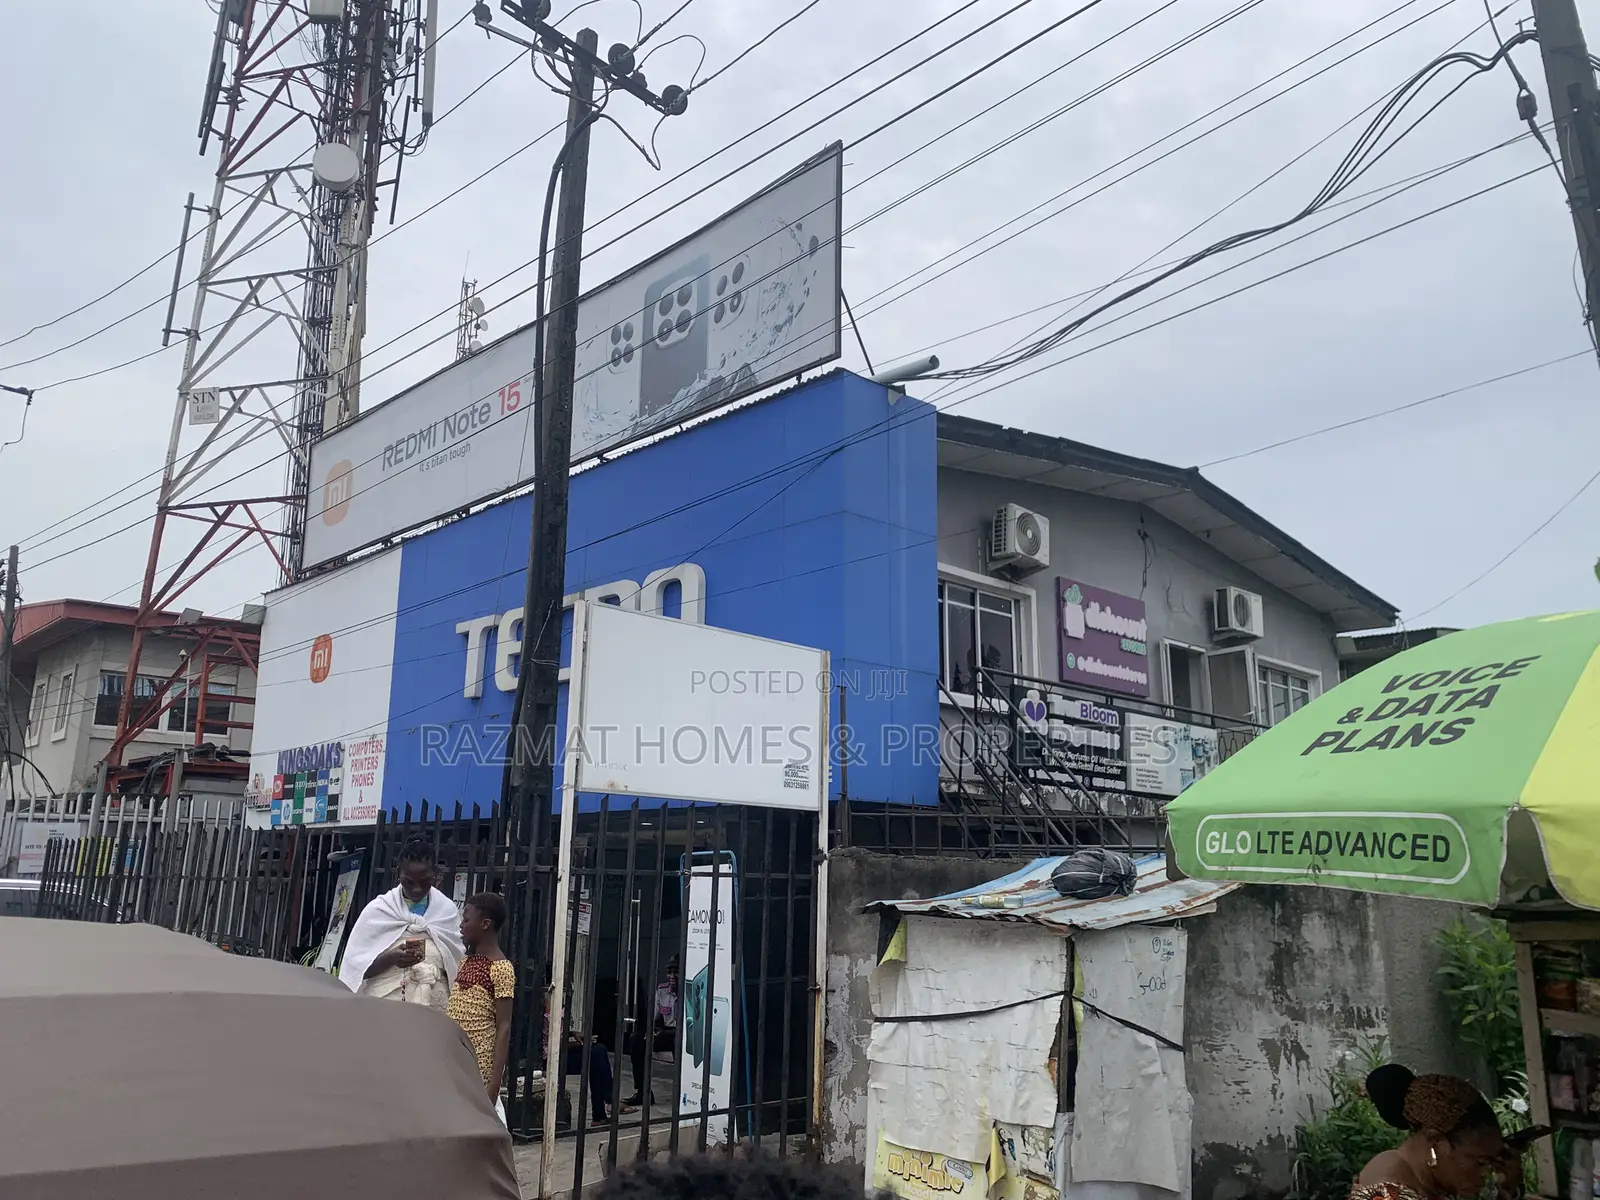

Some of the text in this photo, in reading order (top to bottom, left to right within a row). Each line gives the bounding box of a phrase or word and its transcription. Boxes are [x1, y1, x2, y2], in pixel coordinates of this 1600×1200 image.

[193, 391, 215, 404] STN
[382, 421, 438, 472] REDMI
[443, 401, 491, 443] Note
[498, 381, 521, 416] 15
[449, 442, 471, 459] tough
[1380, 654, 1542, 694] VOICE
[1336, 684, 1501, 725] & DATA
[1300, 717, 1476, 757] PLANS
[348, 739, 384, 757] COMPUTERS
[350, 756, 379, 772] PRINTERS
[1094, 764, 1106, 773] Best
[1106, 766, 1122, 775] Seller
[351, 772, 375, 788] PHONES
[358, 789, 363, 804] &
[1205, 830, 1451, 863] GLO LTE ADVANCED
